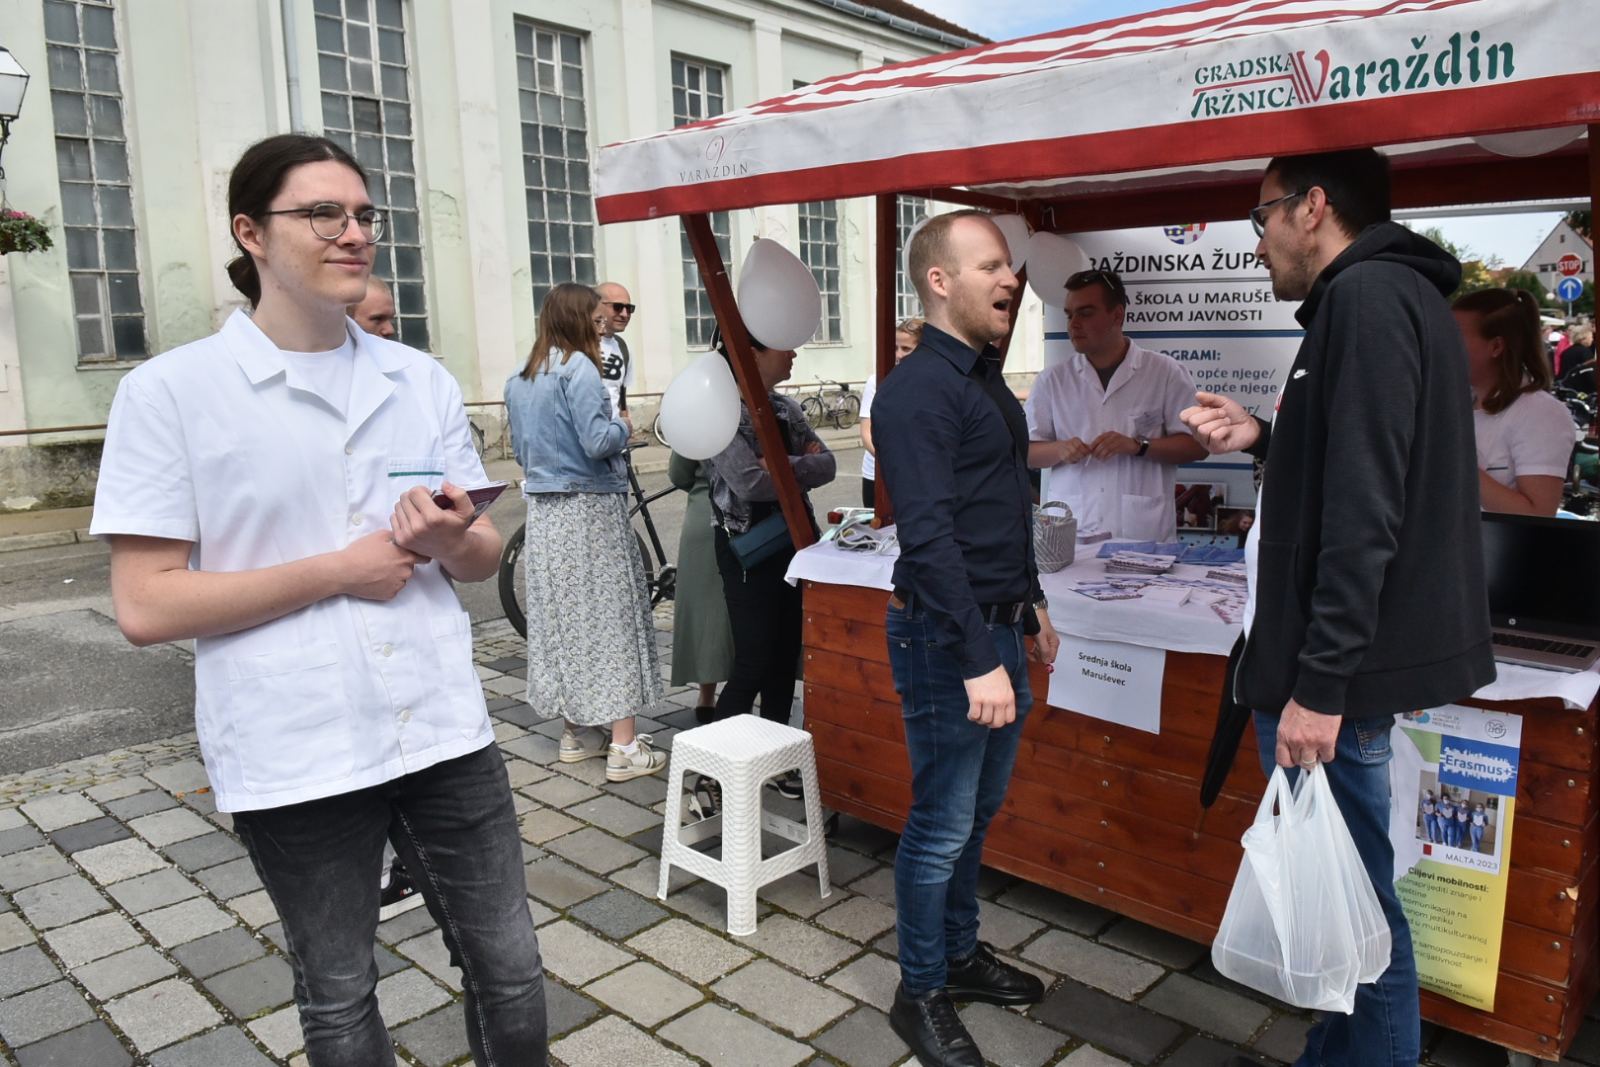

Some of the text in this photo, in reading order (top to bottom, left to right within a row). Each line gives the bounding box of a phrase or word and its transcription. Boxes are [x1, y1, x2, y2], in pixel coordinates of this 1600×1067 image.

[1194, 52, 1294, 85] GRADSKA
[1297, 30, 1515, 102] Varaždin
[1191, 86, 1298, 118] TRŽNICA
[1559, 260, 1580, 271] STOP
[1135, 291, 1183, 305] ŠKOLA
[1188, 293, 1199, 304] U
[1205, 289, 1272, 304] MARUŠE
[1126, 310, 1262, 323] RAVOM JAVNOSTI
[1197, 368, 1228, 380] opće
[1232, 368, 1276, 380] njege/
[1205, 383, 1236, 394] opće
[1241, 383, 1277, 394] njege
[1078, 652, 1132, 672] Srednja škola
[1082, 668, 1126, 686] Maruševec
[1446, 754, 1509, 776] Erasmus+
[1446, 853, 1498, 870] MALTA 2023
[1408, 867, 1489, 893] Ciljevi mobilnosti:
